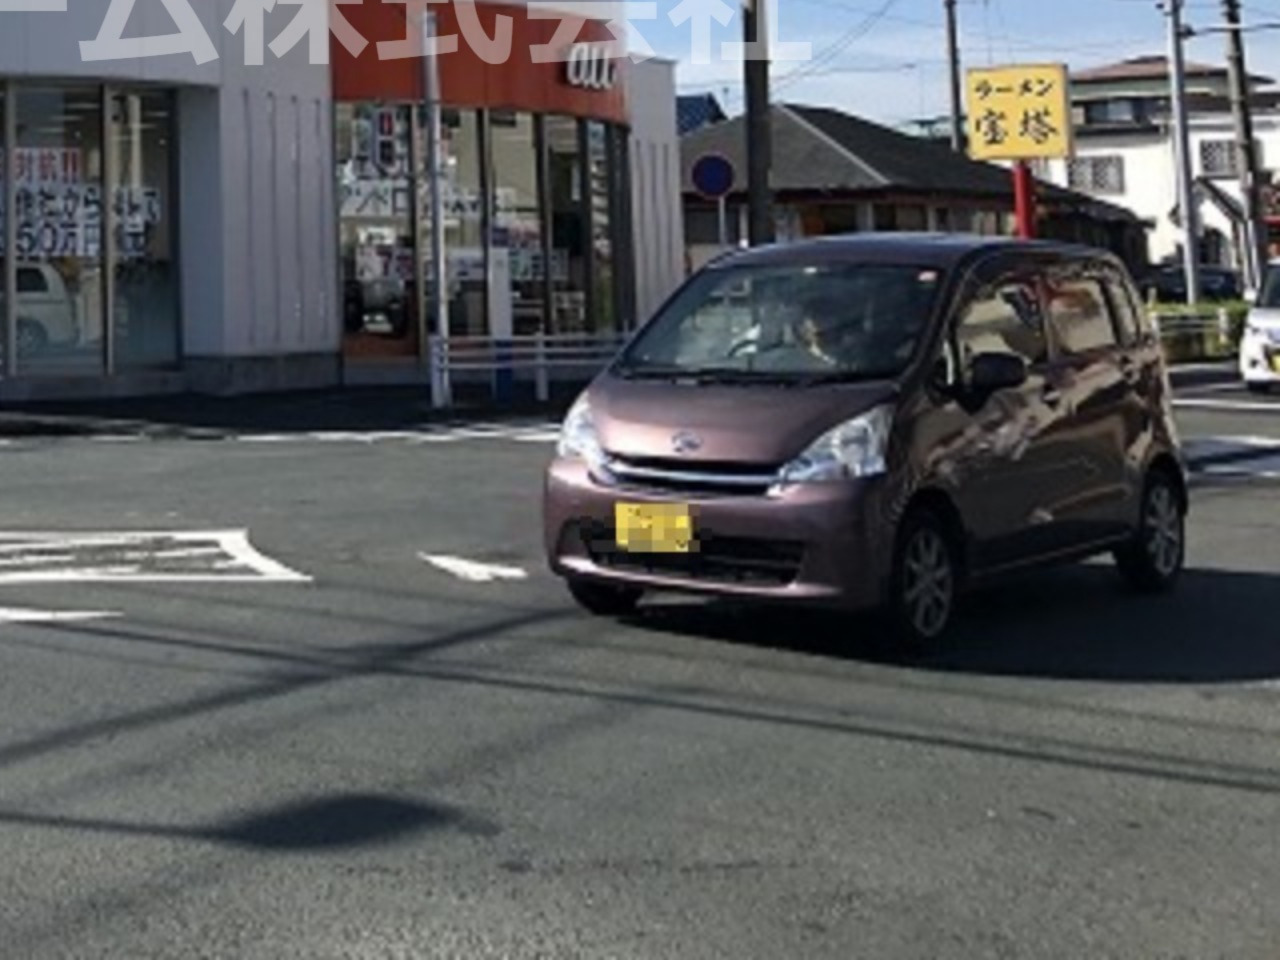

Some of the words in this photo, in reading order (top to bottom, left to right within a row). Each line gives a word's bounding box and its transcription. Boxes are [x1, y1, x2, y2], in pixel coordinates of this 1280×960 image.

[566, 42, 618, 90] au
[974, 77, 1055, 100] ラーメン
[974, 107, 1058, 146] 宝塔
